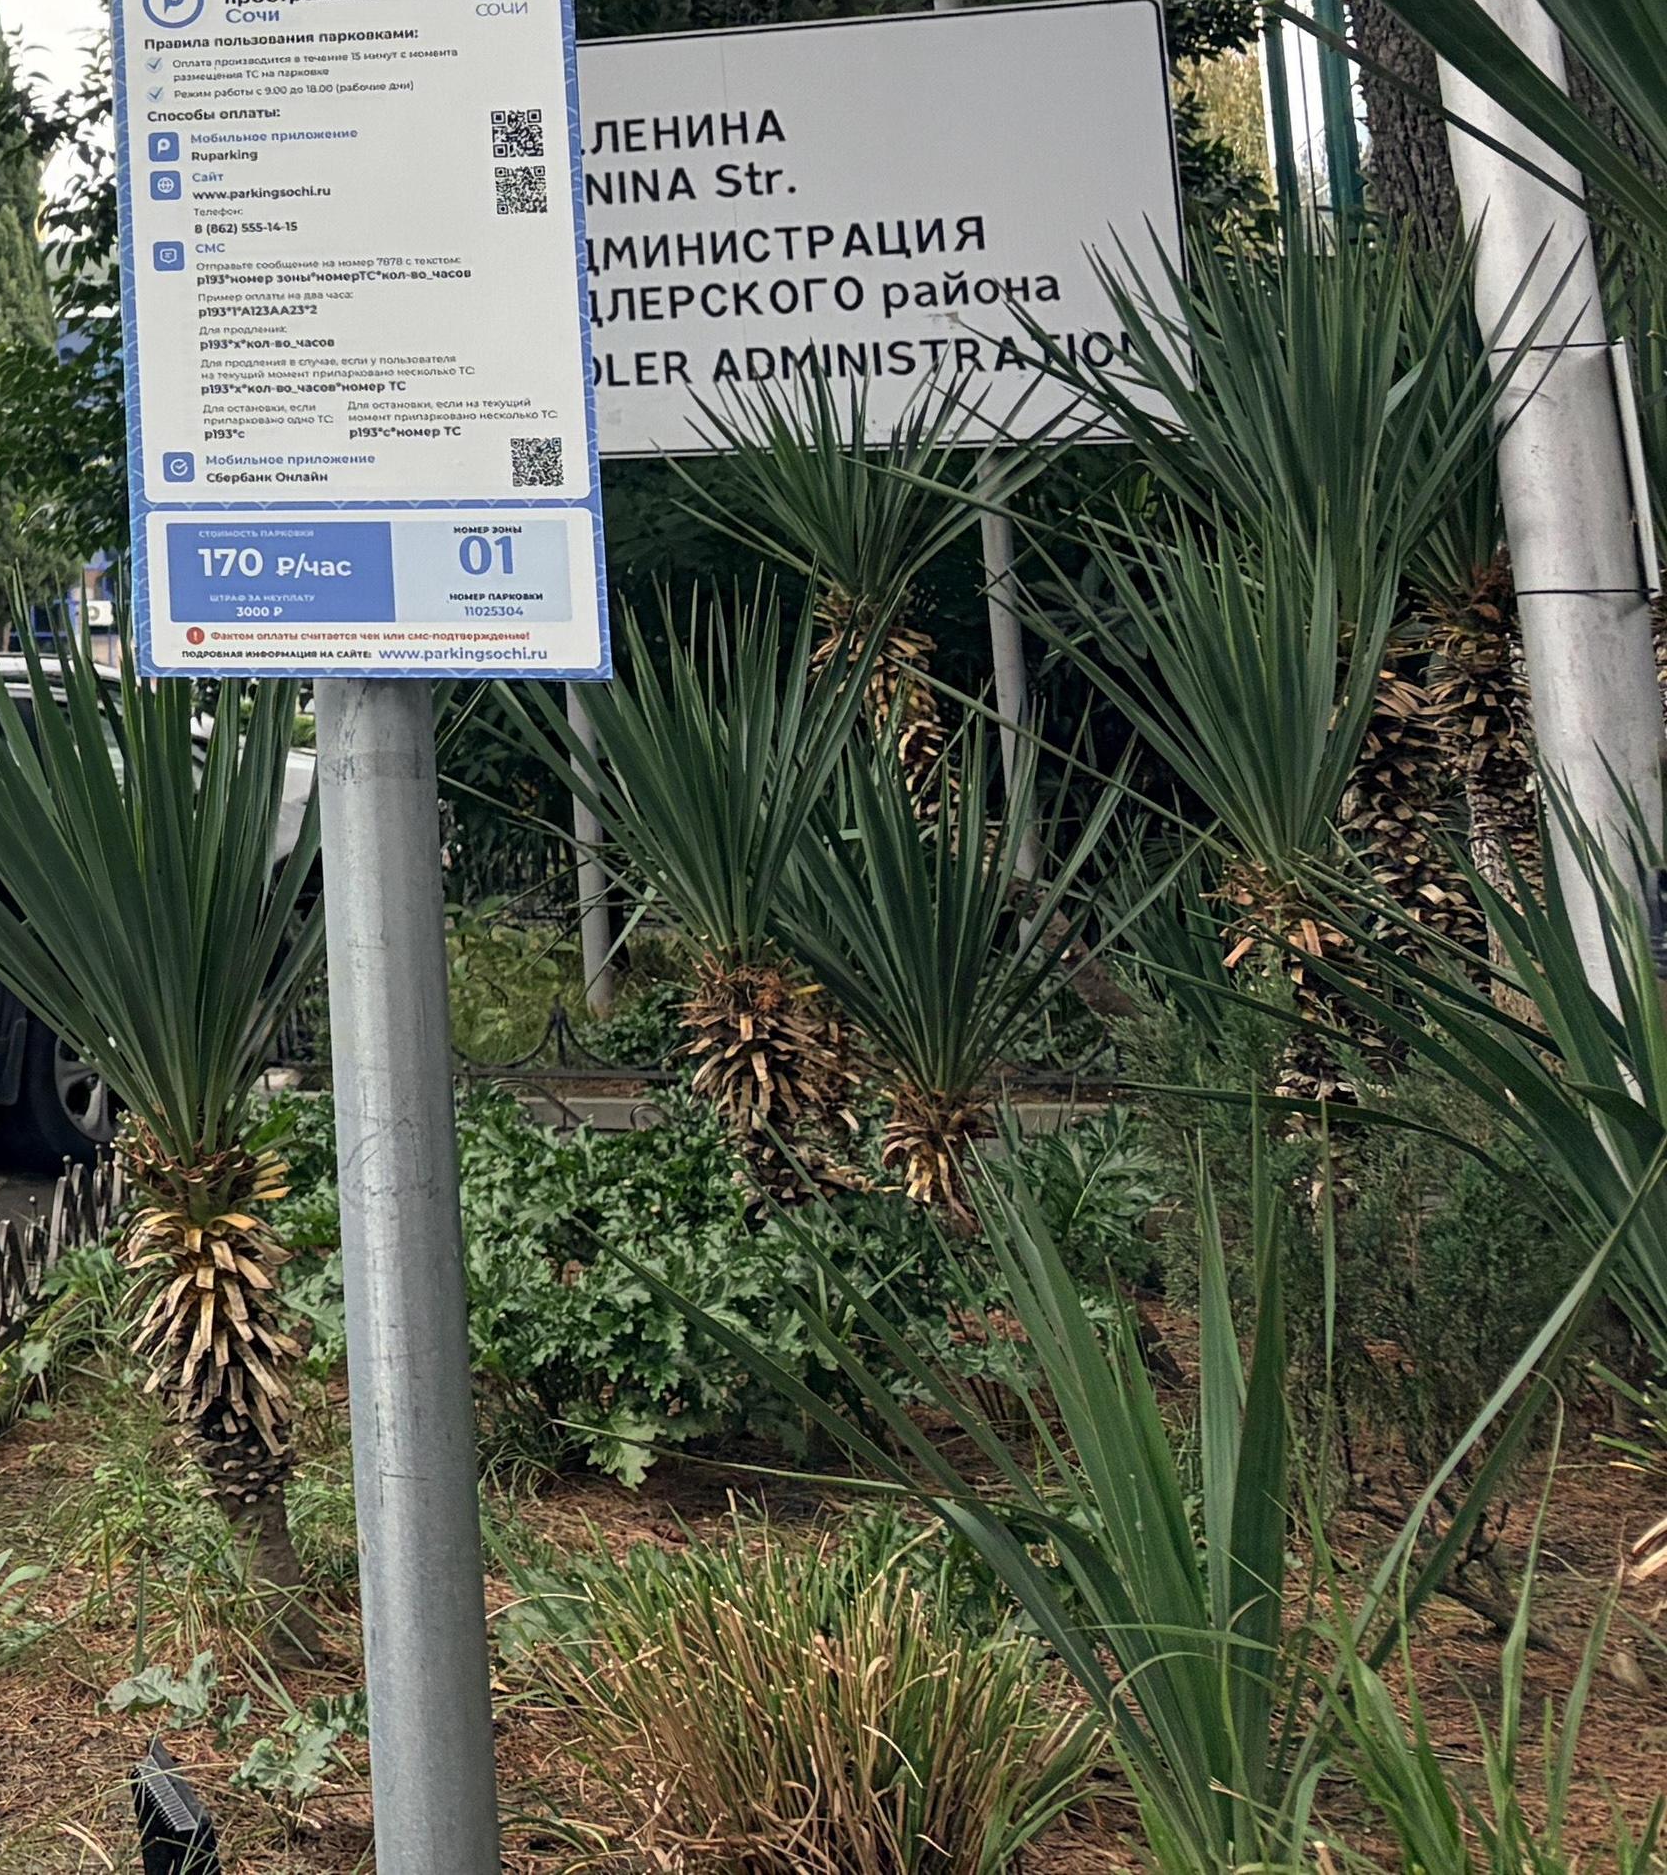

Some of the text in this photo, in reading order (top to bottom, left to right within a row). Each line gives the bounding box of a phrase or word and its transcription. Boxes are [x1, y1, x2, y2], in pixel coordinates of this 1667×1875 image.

[475, 2, 528, 16] СОЧИ
[225, 8, 279, 23] Сочи
[144, 30, 418, 51] Правила пользования парковками:
[172, 60, 212, 68] Оплата
[214, 57, 291, 69] производится
[351, 52, 361, 61] 15
[364, 52, 397, 61] минут
[409, 49, 458, 58] момента
[173, 72, 243, 82] размещения
[246, 70, 259, 78] ТС
[277, 69, 329, 78] парковке
[174, 90, 211, 98] Режим
[214, 88, 254, 99] работы
[264, 86, 287, 95] 9.00
[289, 87, 304, 95] до
[306, 84, 333, 93] 18.00
[336, 83, 386, 93] (рабочие
[388, 81, 414, 91] дни)
[147, 109, 280, 122] Способы оплаты:
[191, 130, 358, 143] Мобильное приложение
[191, 150, 258, 162] Ruparking
[192, 172, 224, 182] Сайт
[715, 161, 797, 198] Str.
[192, 186, 331, 200] www.parkingsochi.ru
[195, 222, 298, 236] 8 (862) 555-14-15
[195, 243, 225, 253] СМС
[196, 257, 461, 271] Отправьте сообщение на номер 7878 с текстом:
[198, 293, 243, 303] Пример
[245, 293, 285, 301] оплаты
[304, 292, 324, 300] два
[882, 270, 1061, 318] района
[199, 326, 221, 336] Для
[200, 359, 222, 368] Для
[225, 360, 286, 368] продления
[298, 359, 338, 367] случае,
[370, 358, 376, 366] у
[379, 356, 456, 364] пользователя
[217, 371, 265, 380] текущий
[313, 370, 395, 378] припарковано
[397, 368, 456, 376] несколько
[458, 366, 475, 375] ТС:
[592, 350, 691, 387] LER
[389, 381, 406, 391] ТС
[202, 404, 224, 414] Для
[227, 405, 287, 413] остановки,
[347, 401, 369, 411] Для
[482, 398, 531, 409] текущий
[204, 417, 285, 425] припарковано
[317, 415, 334, 423] ТС:
[348, 414, 391, 422] момент
[394, 413, 477, 422] припарковано
[541, 410, 558, 419] ТС:
[443, 426, 461, 436] ТС
[206, 455, 375, 466] Мобильное приложение
[206, 472, 328, 484] Сбербанк Онлайн
[198, 530, 258, 538] СТОИМОСТЬ
[453, 526, 522, 534] НОМЕР ЗОНЫ
[459, 536, 513, 575] 01
[198, 548, 263, 576] 170
[236, 606, 270, 617] 3000
[464, 606, 524, 616] 11025304
[210, 632, 254, 640] Фактом
[407, 632, 530, 641] смс-подтверждение!
[336, 650, 371, 658] САЙТЕ:
[378, 647, 547, 662] www.parkingsochi.ru
